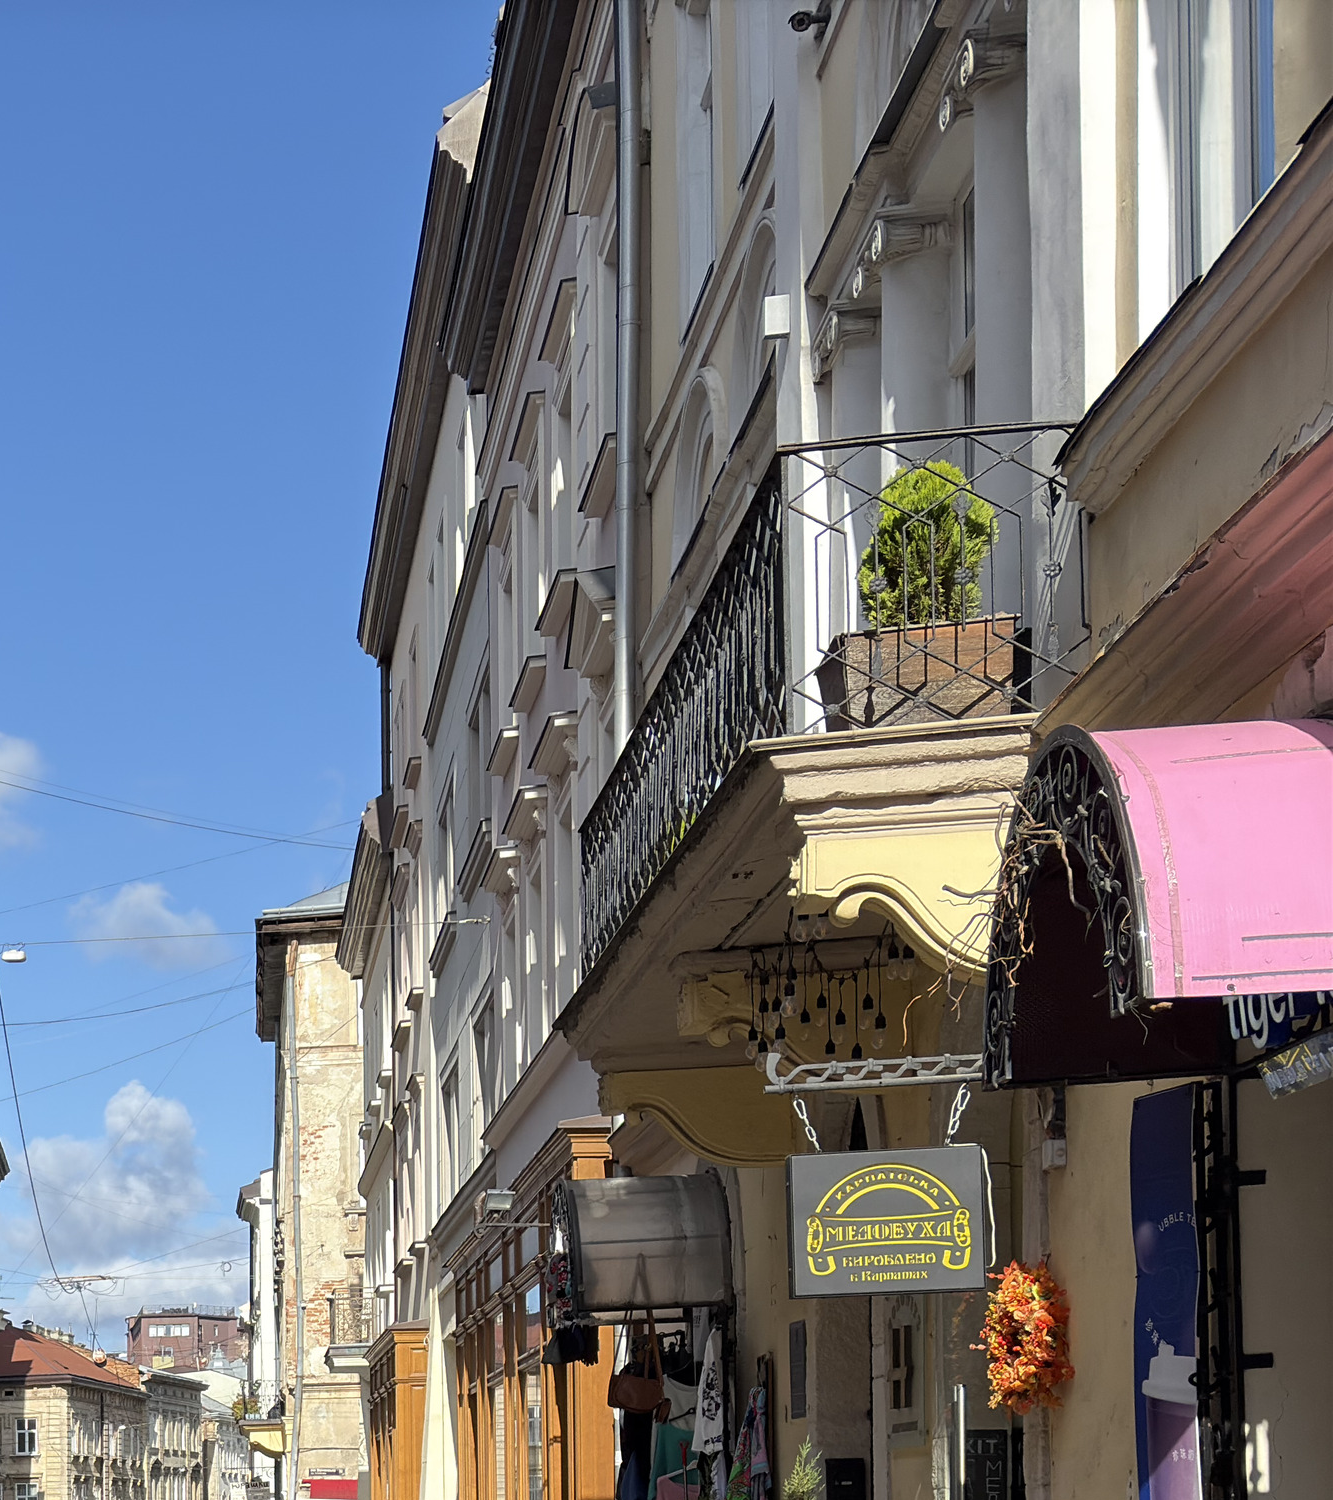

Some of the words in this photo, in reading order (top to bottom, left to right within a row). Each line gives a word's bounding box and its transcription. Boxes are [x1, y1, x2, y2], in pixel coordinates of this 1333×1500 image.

[825, 1220, 952, 1242] МЕДОВУХА
[842, 1252, 937, 1268] ВИРОБЛЕНО
[861, 1270, 929, 1283] Карпатах
